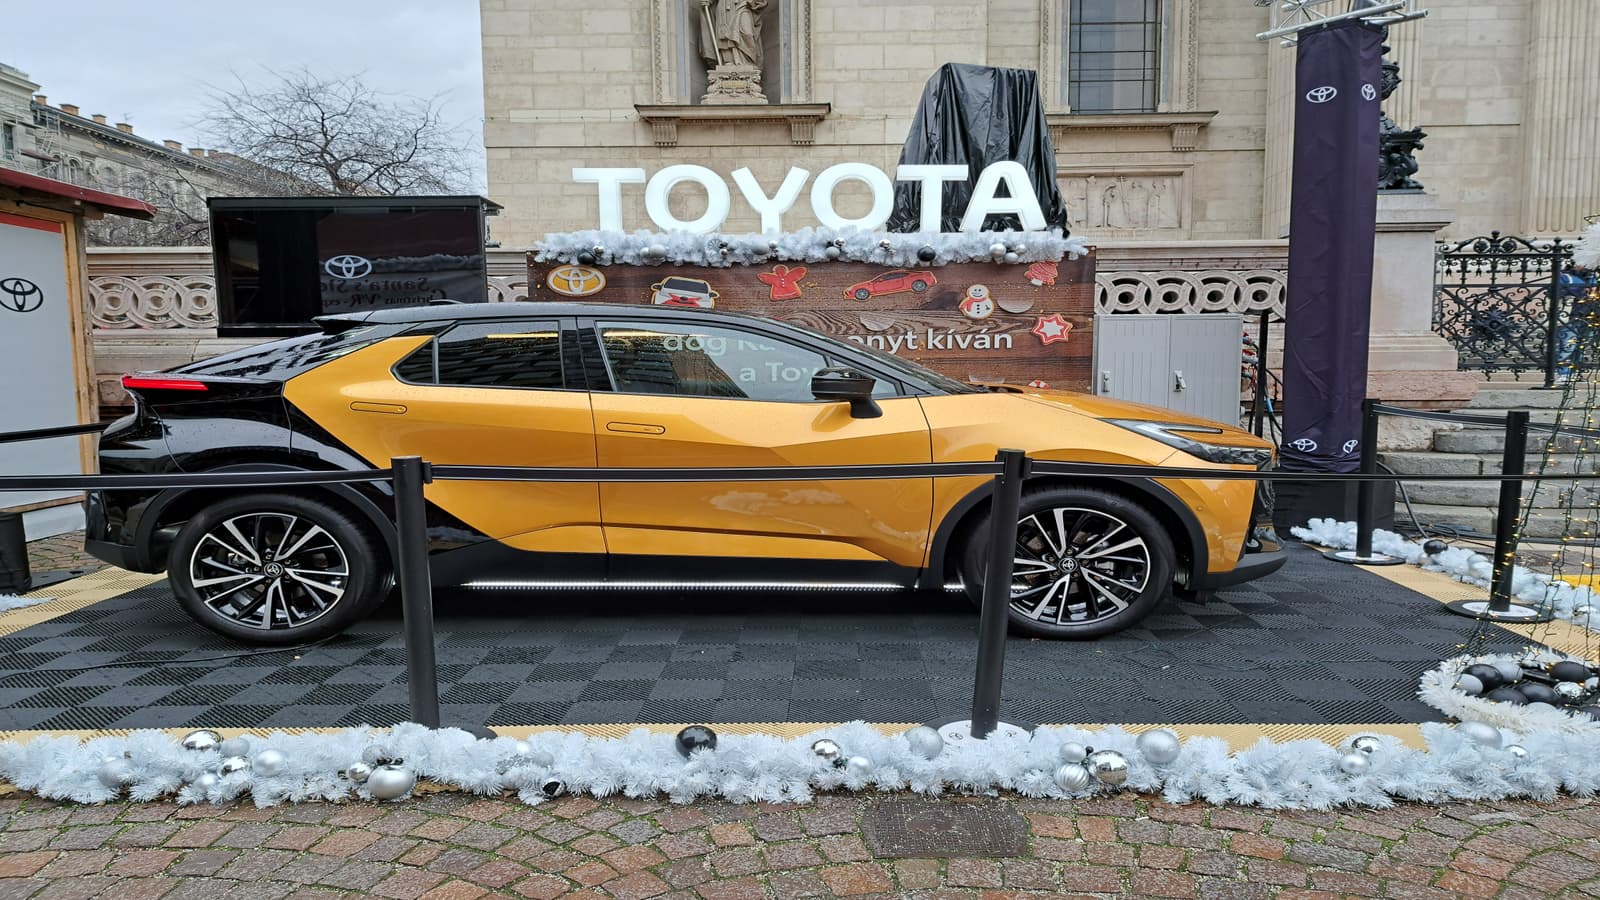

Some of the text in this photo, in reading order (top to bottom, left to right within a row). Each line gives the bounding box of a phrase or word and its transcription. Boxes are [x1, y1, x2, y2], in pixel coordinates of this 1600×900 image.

[572, 160, 1048, 234] TOYOTA
[927, 328, 1012, 349] kíván
[740, 367, 756, 382] a
